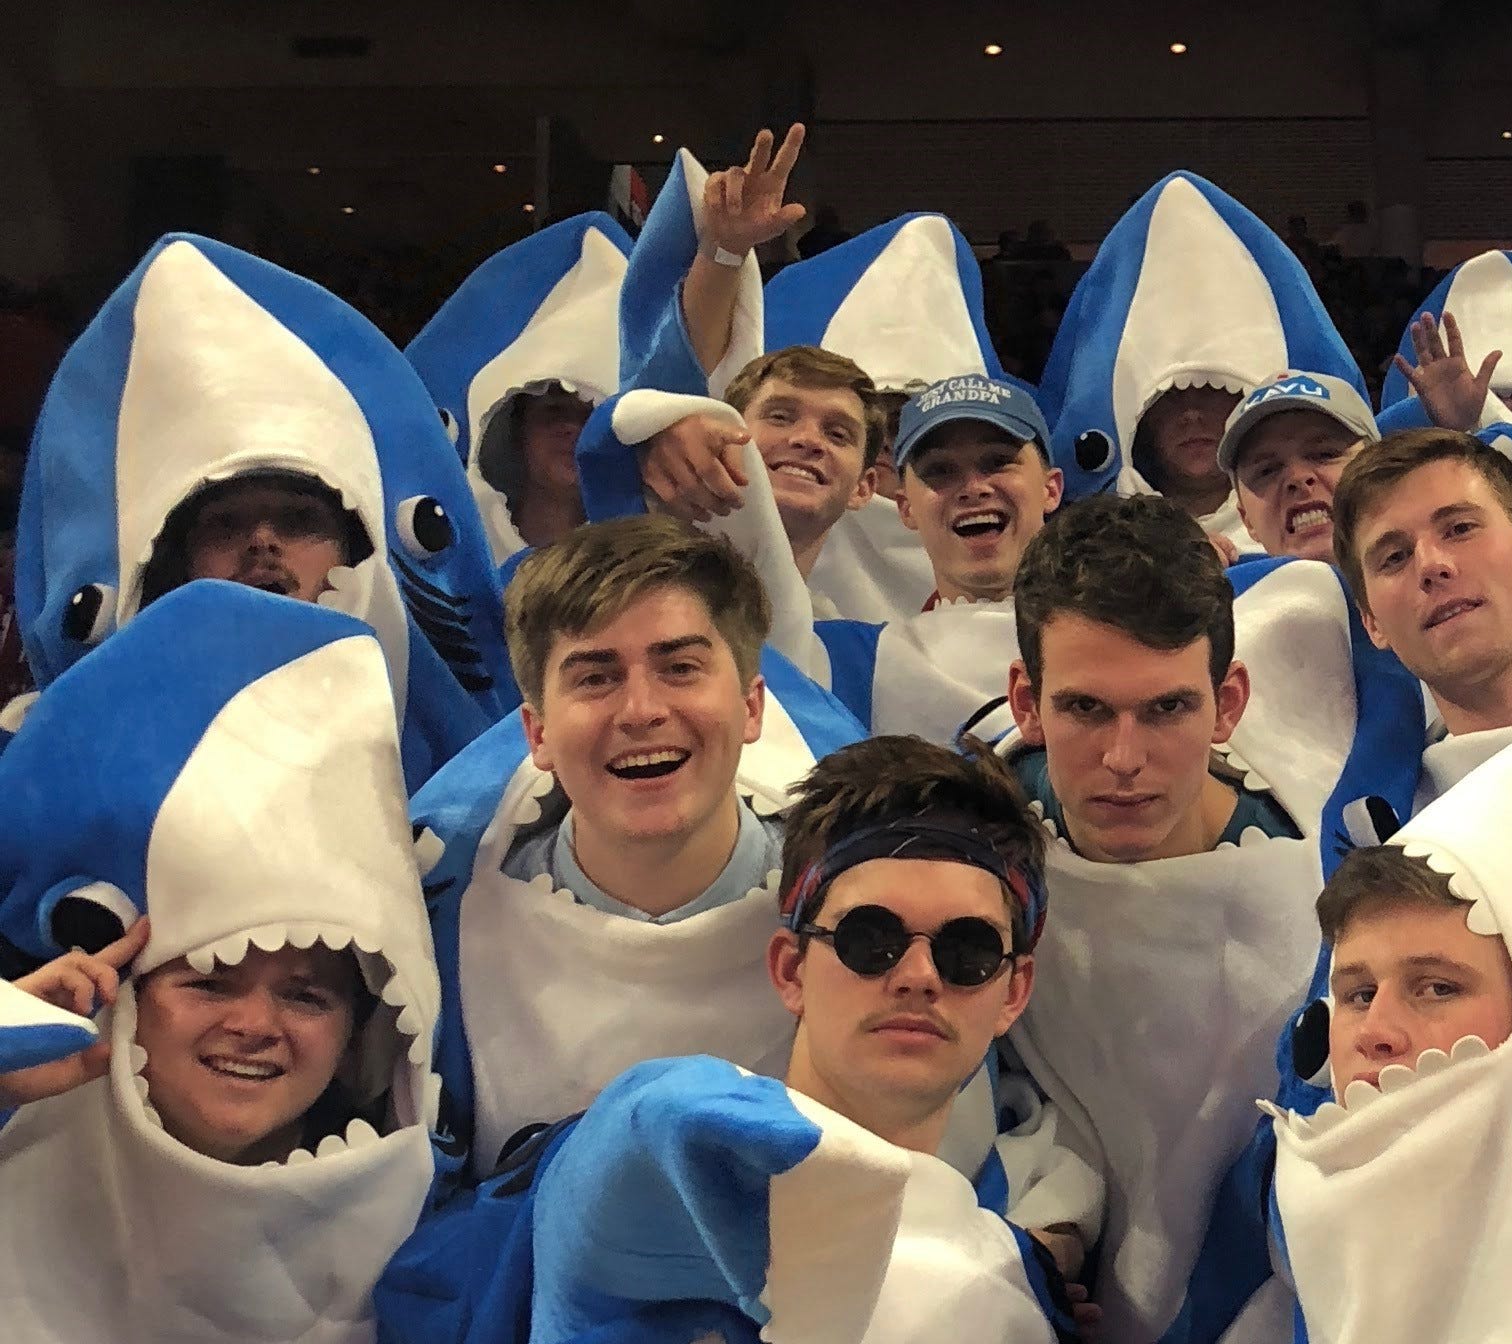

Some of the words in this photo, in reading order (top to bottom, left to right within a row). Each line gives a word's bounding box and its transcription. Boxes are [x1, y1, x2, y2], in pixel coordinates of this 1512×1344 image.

[948, 377, 988, 392] CALL
[987, 382, 1012, 399] ME
[921, 388, 1001, 413] GRANDPA
